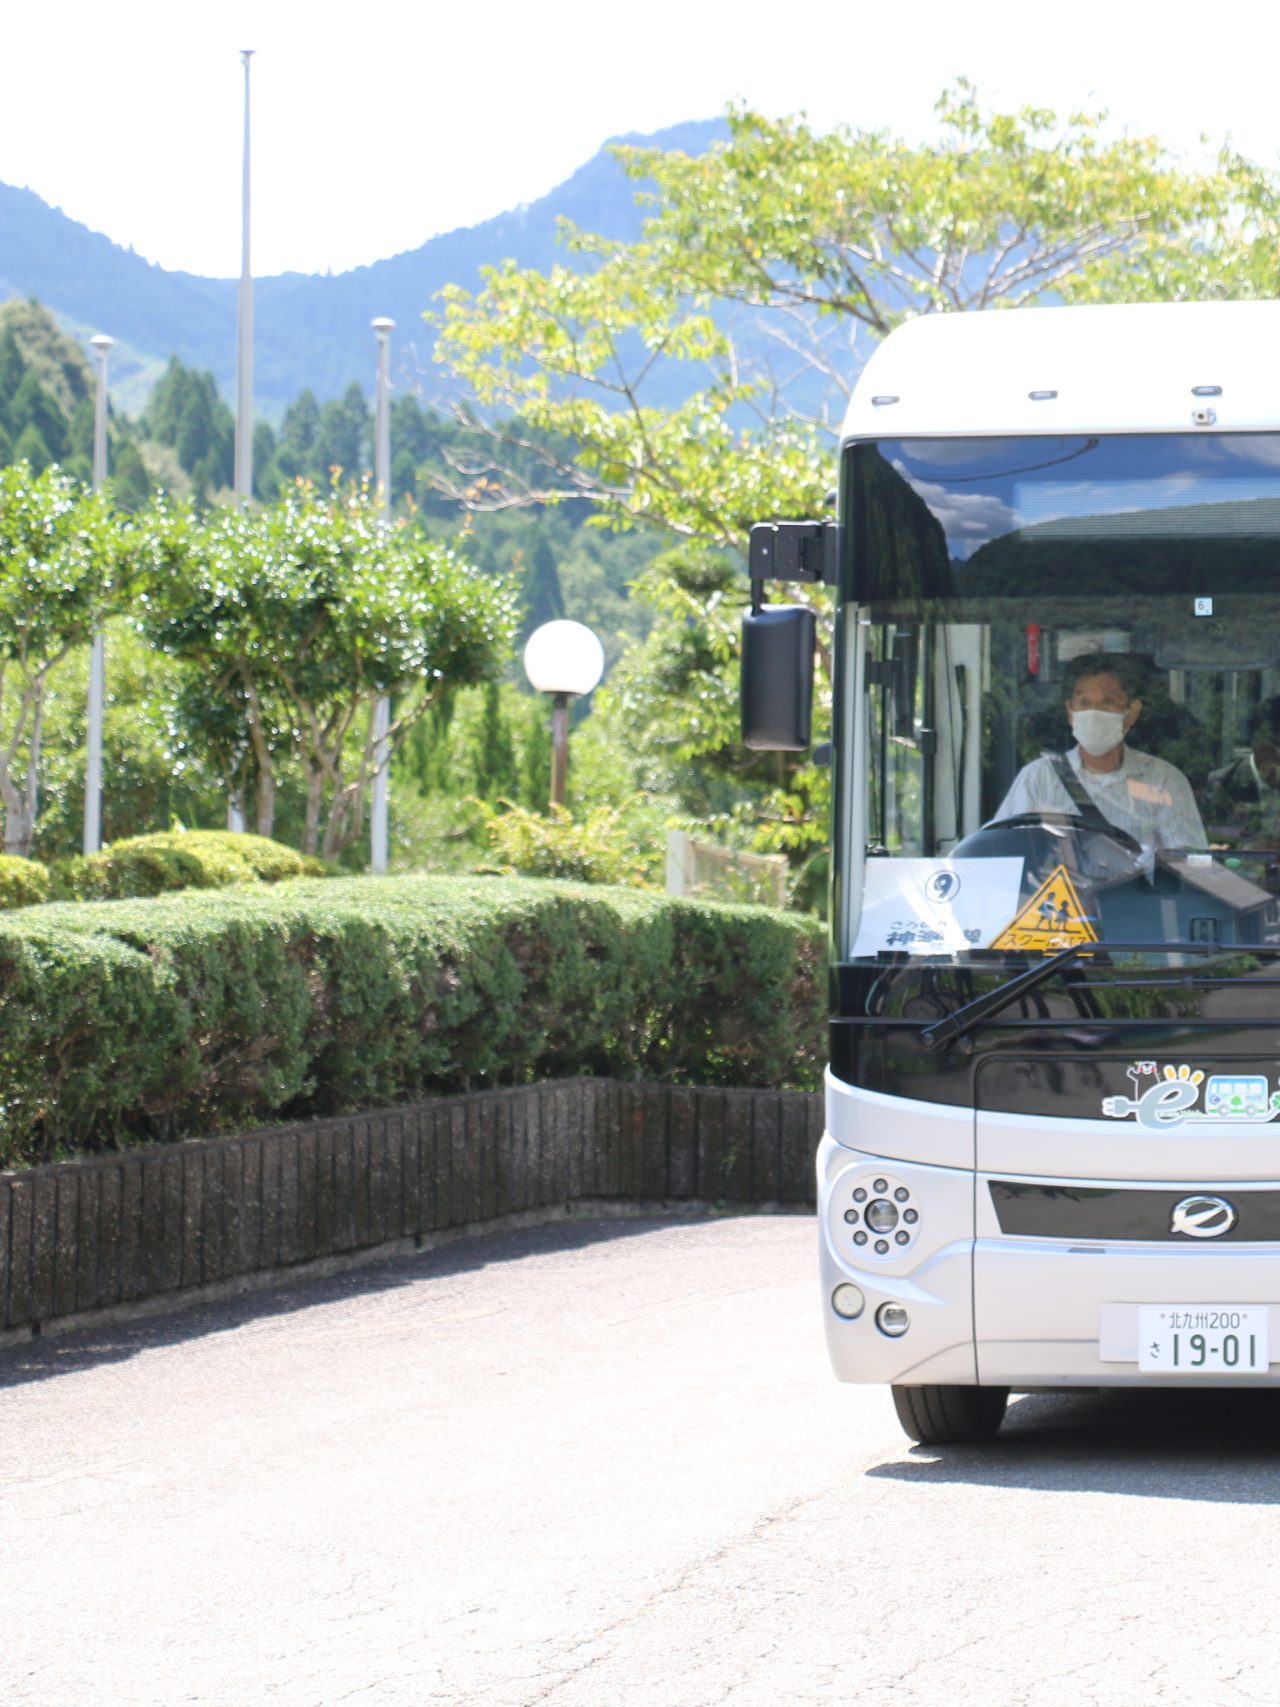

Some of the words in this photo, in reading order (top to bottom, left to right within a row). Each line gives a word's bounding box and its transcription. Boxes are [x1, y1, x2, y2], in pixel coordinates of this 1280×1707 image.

[934, 873, 953, 898] 9
[1150, 1341, 1160, 1359] さ
[1173, 1334, 1256, 1367] 19-01
